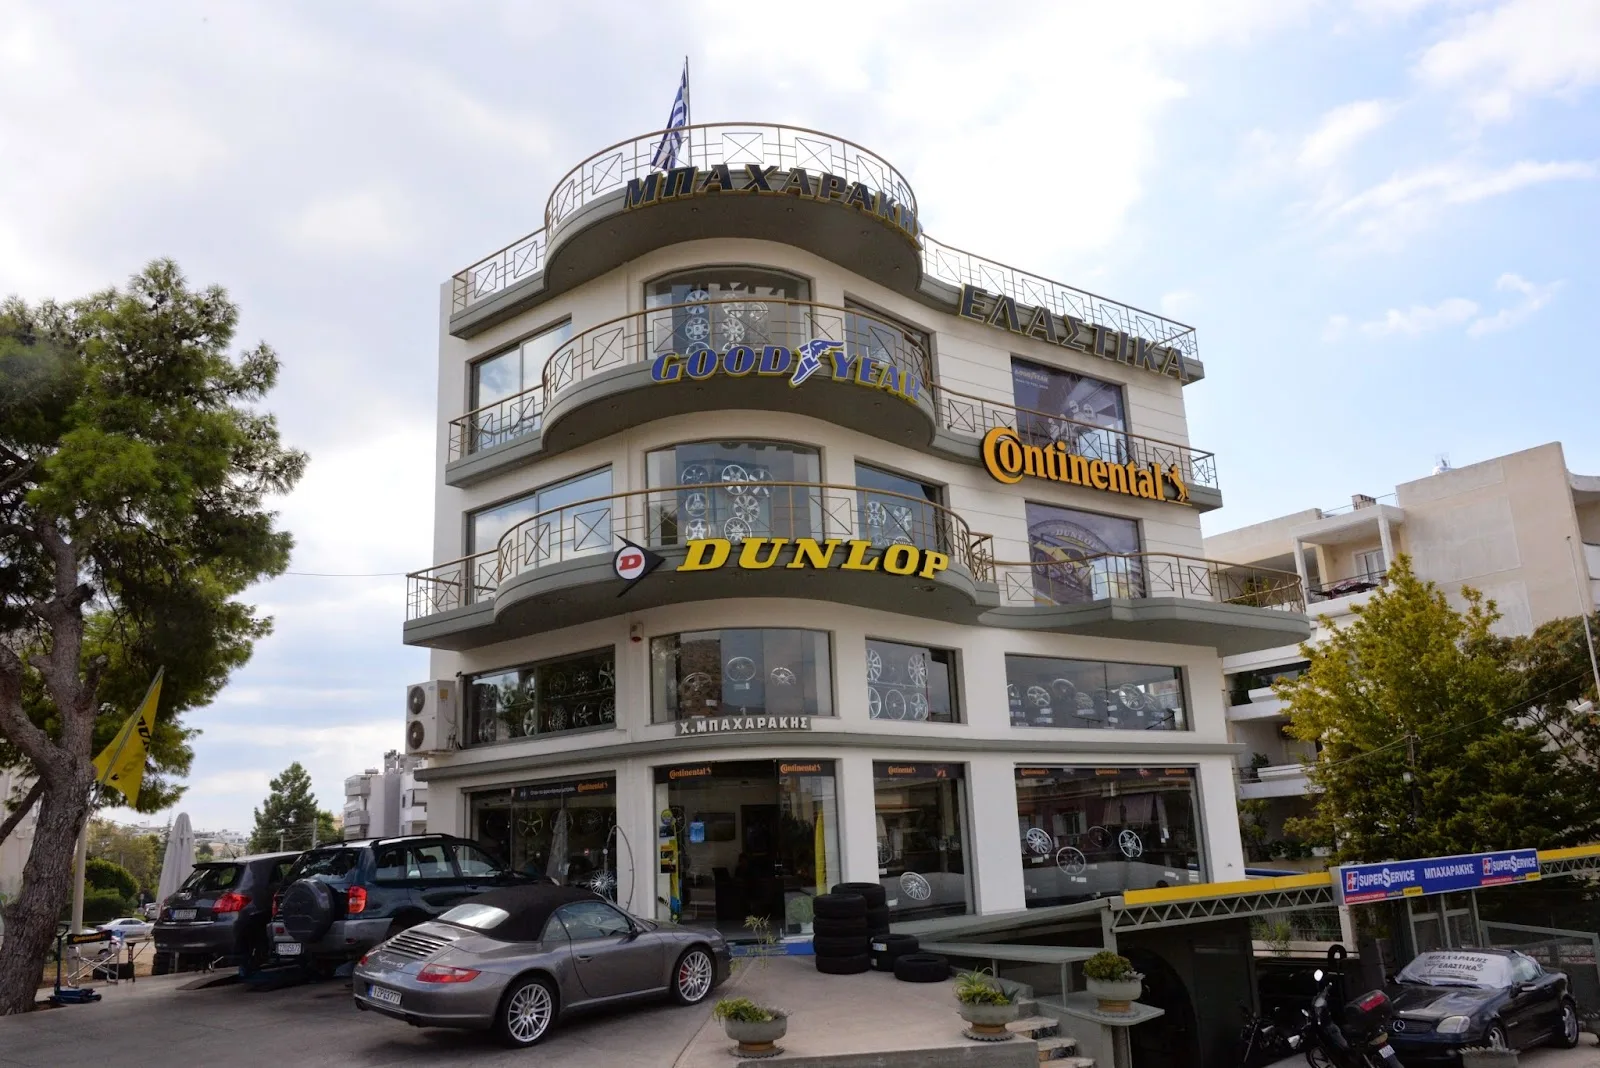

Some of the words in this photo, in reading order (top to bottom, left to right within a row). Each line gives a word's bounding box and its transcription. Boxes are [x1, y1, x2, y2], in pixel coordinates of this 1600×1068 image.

[959, 283, 1189, 381] ΕΛΑΣΤΙΚΑ
[982, 426, 1166, 501] Continental
[676, 537, 949, 580] DUNLOP
[669, 767, 706, 779] Continental
[780, 763, 817, 773] Continental
[1424, 863, 1475, 879] ΜΠΑΧΑΡΑΚΗΣ
[1428, 955, 1488, 964] ΜΠΑΧΑΡΑΚΗΣ
[1438, 963, 1477, 971] ΕΛΑΣΤΙΚΑ
